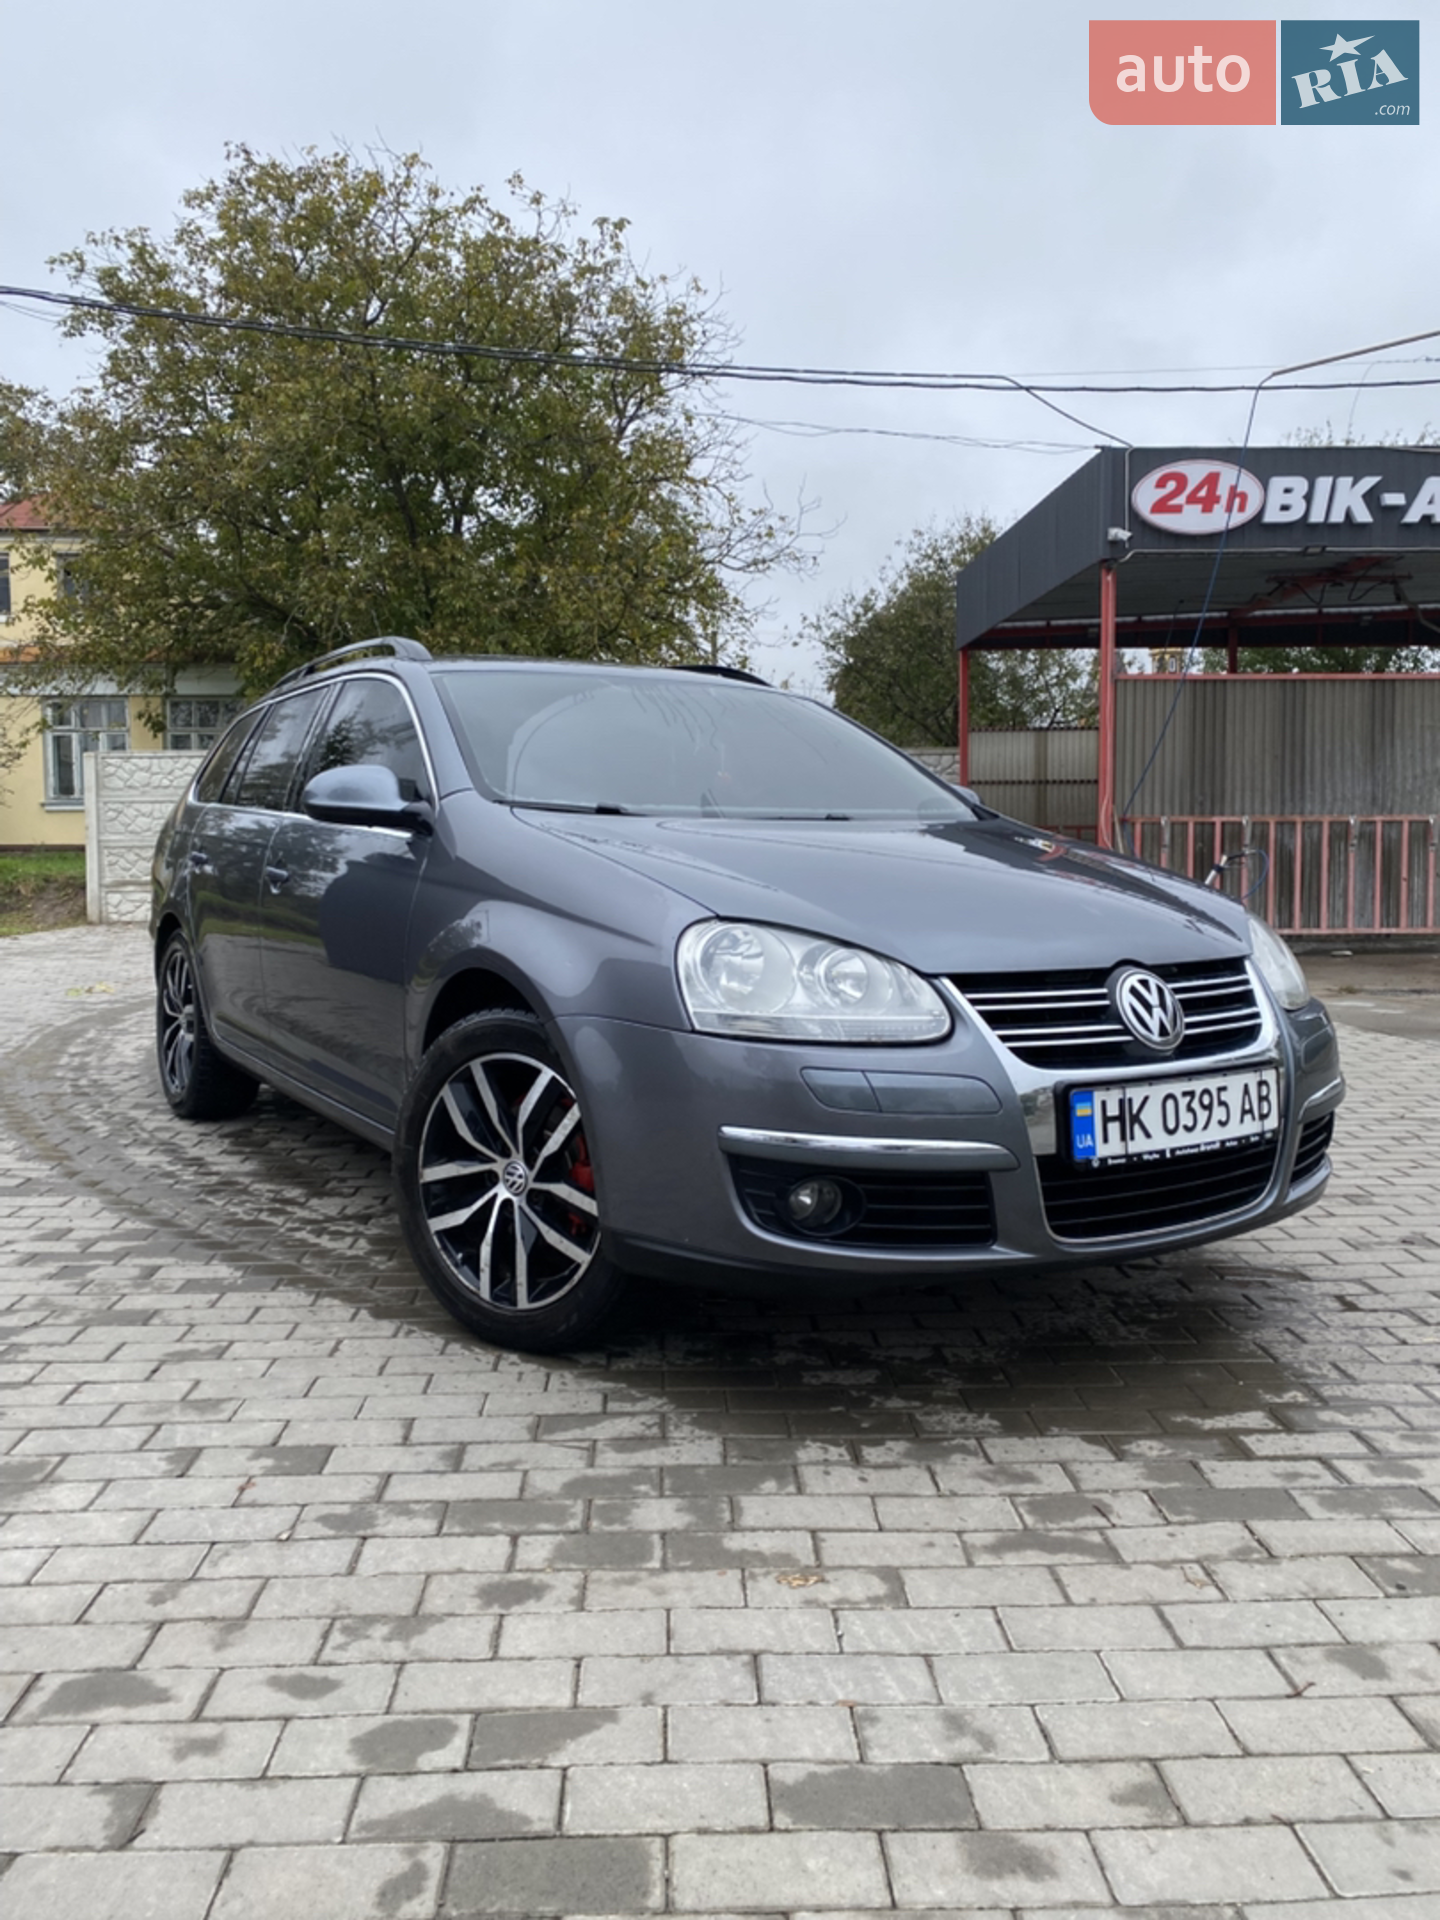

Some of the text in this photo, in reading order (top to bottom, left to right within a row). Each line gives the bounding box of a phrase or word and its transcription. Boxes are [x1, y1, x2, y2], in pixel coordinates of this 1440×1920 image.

[1150, 471, 1249, 514] 24h
[1101, 1080, 1272, 1144] HK 0395 AB
[1076, 1133, 1094, 1149] UA
